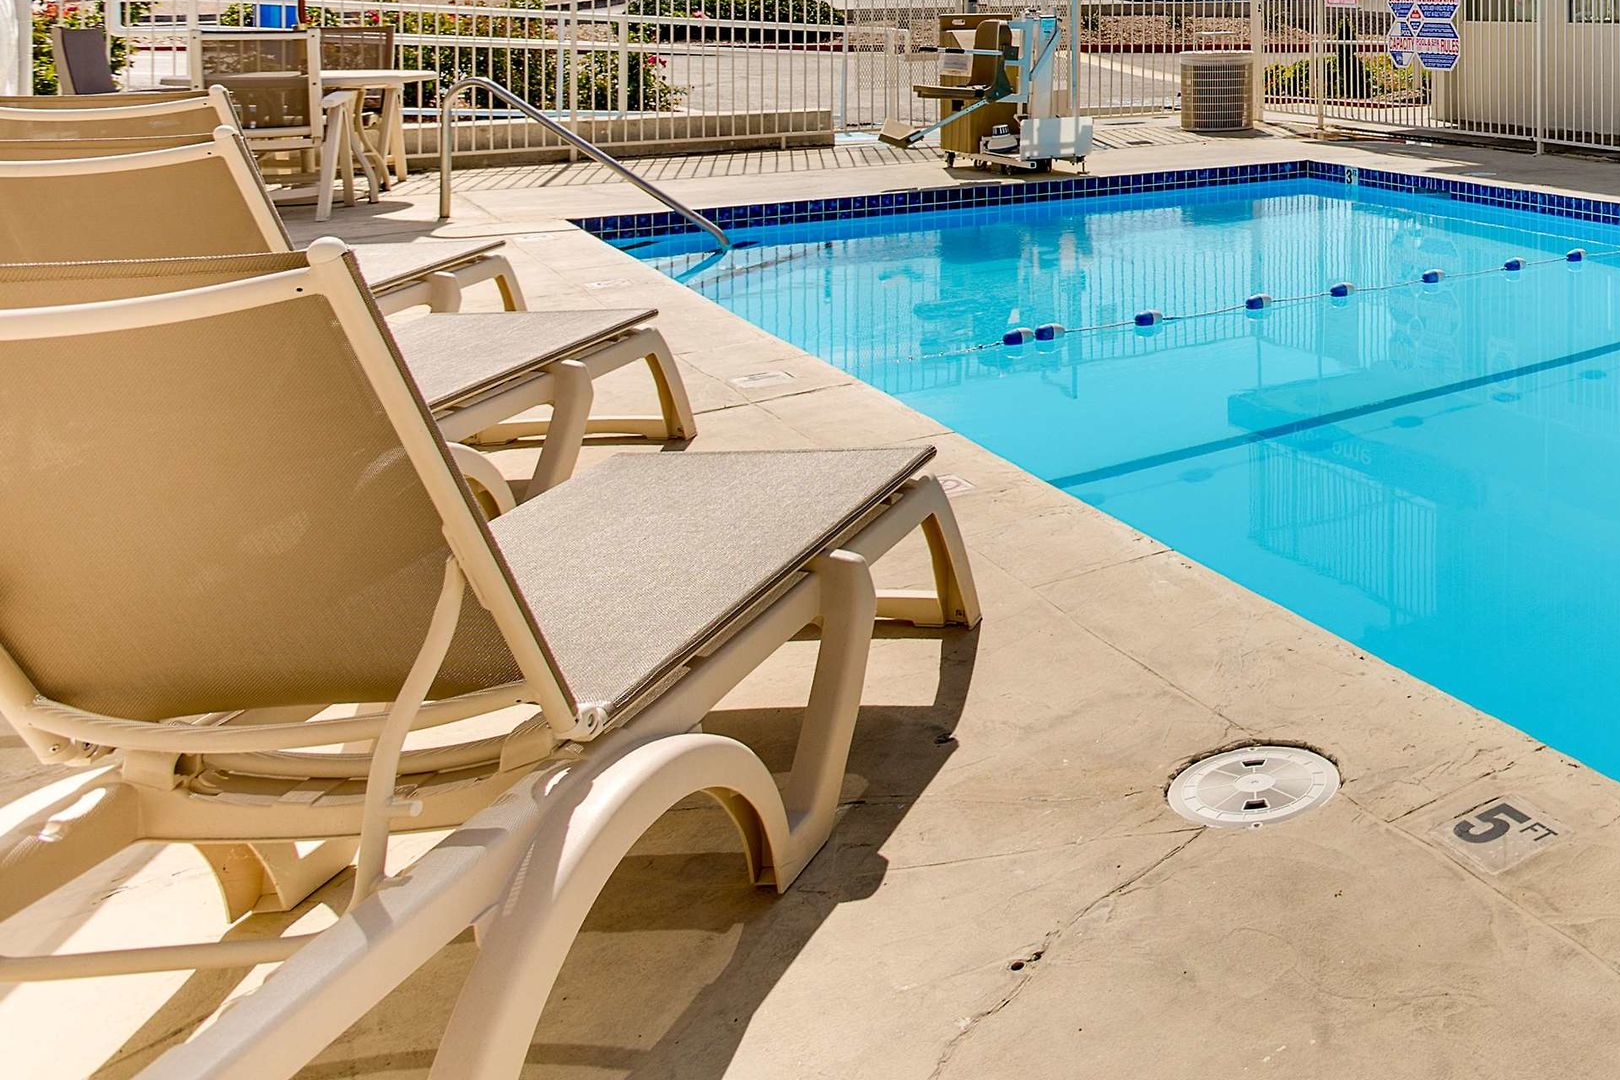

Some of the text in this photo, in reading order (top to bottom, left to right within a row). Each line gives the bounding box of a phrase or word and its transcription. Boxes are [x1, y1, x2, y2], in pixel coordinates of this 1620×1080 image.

[1389, 37, 1414, 50] CAPACITY
[1440, 39, 1459, 53] RULES
[1346, 169, 1353, 184] 3
[1453, 803, 1559, 844] 5 FT
